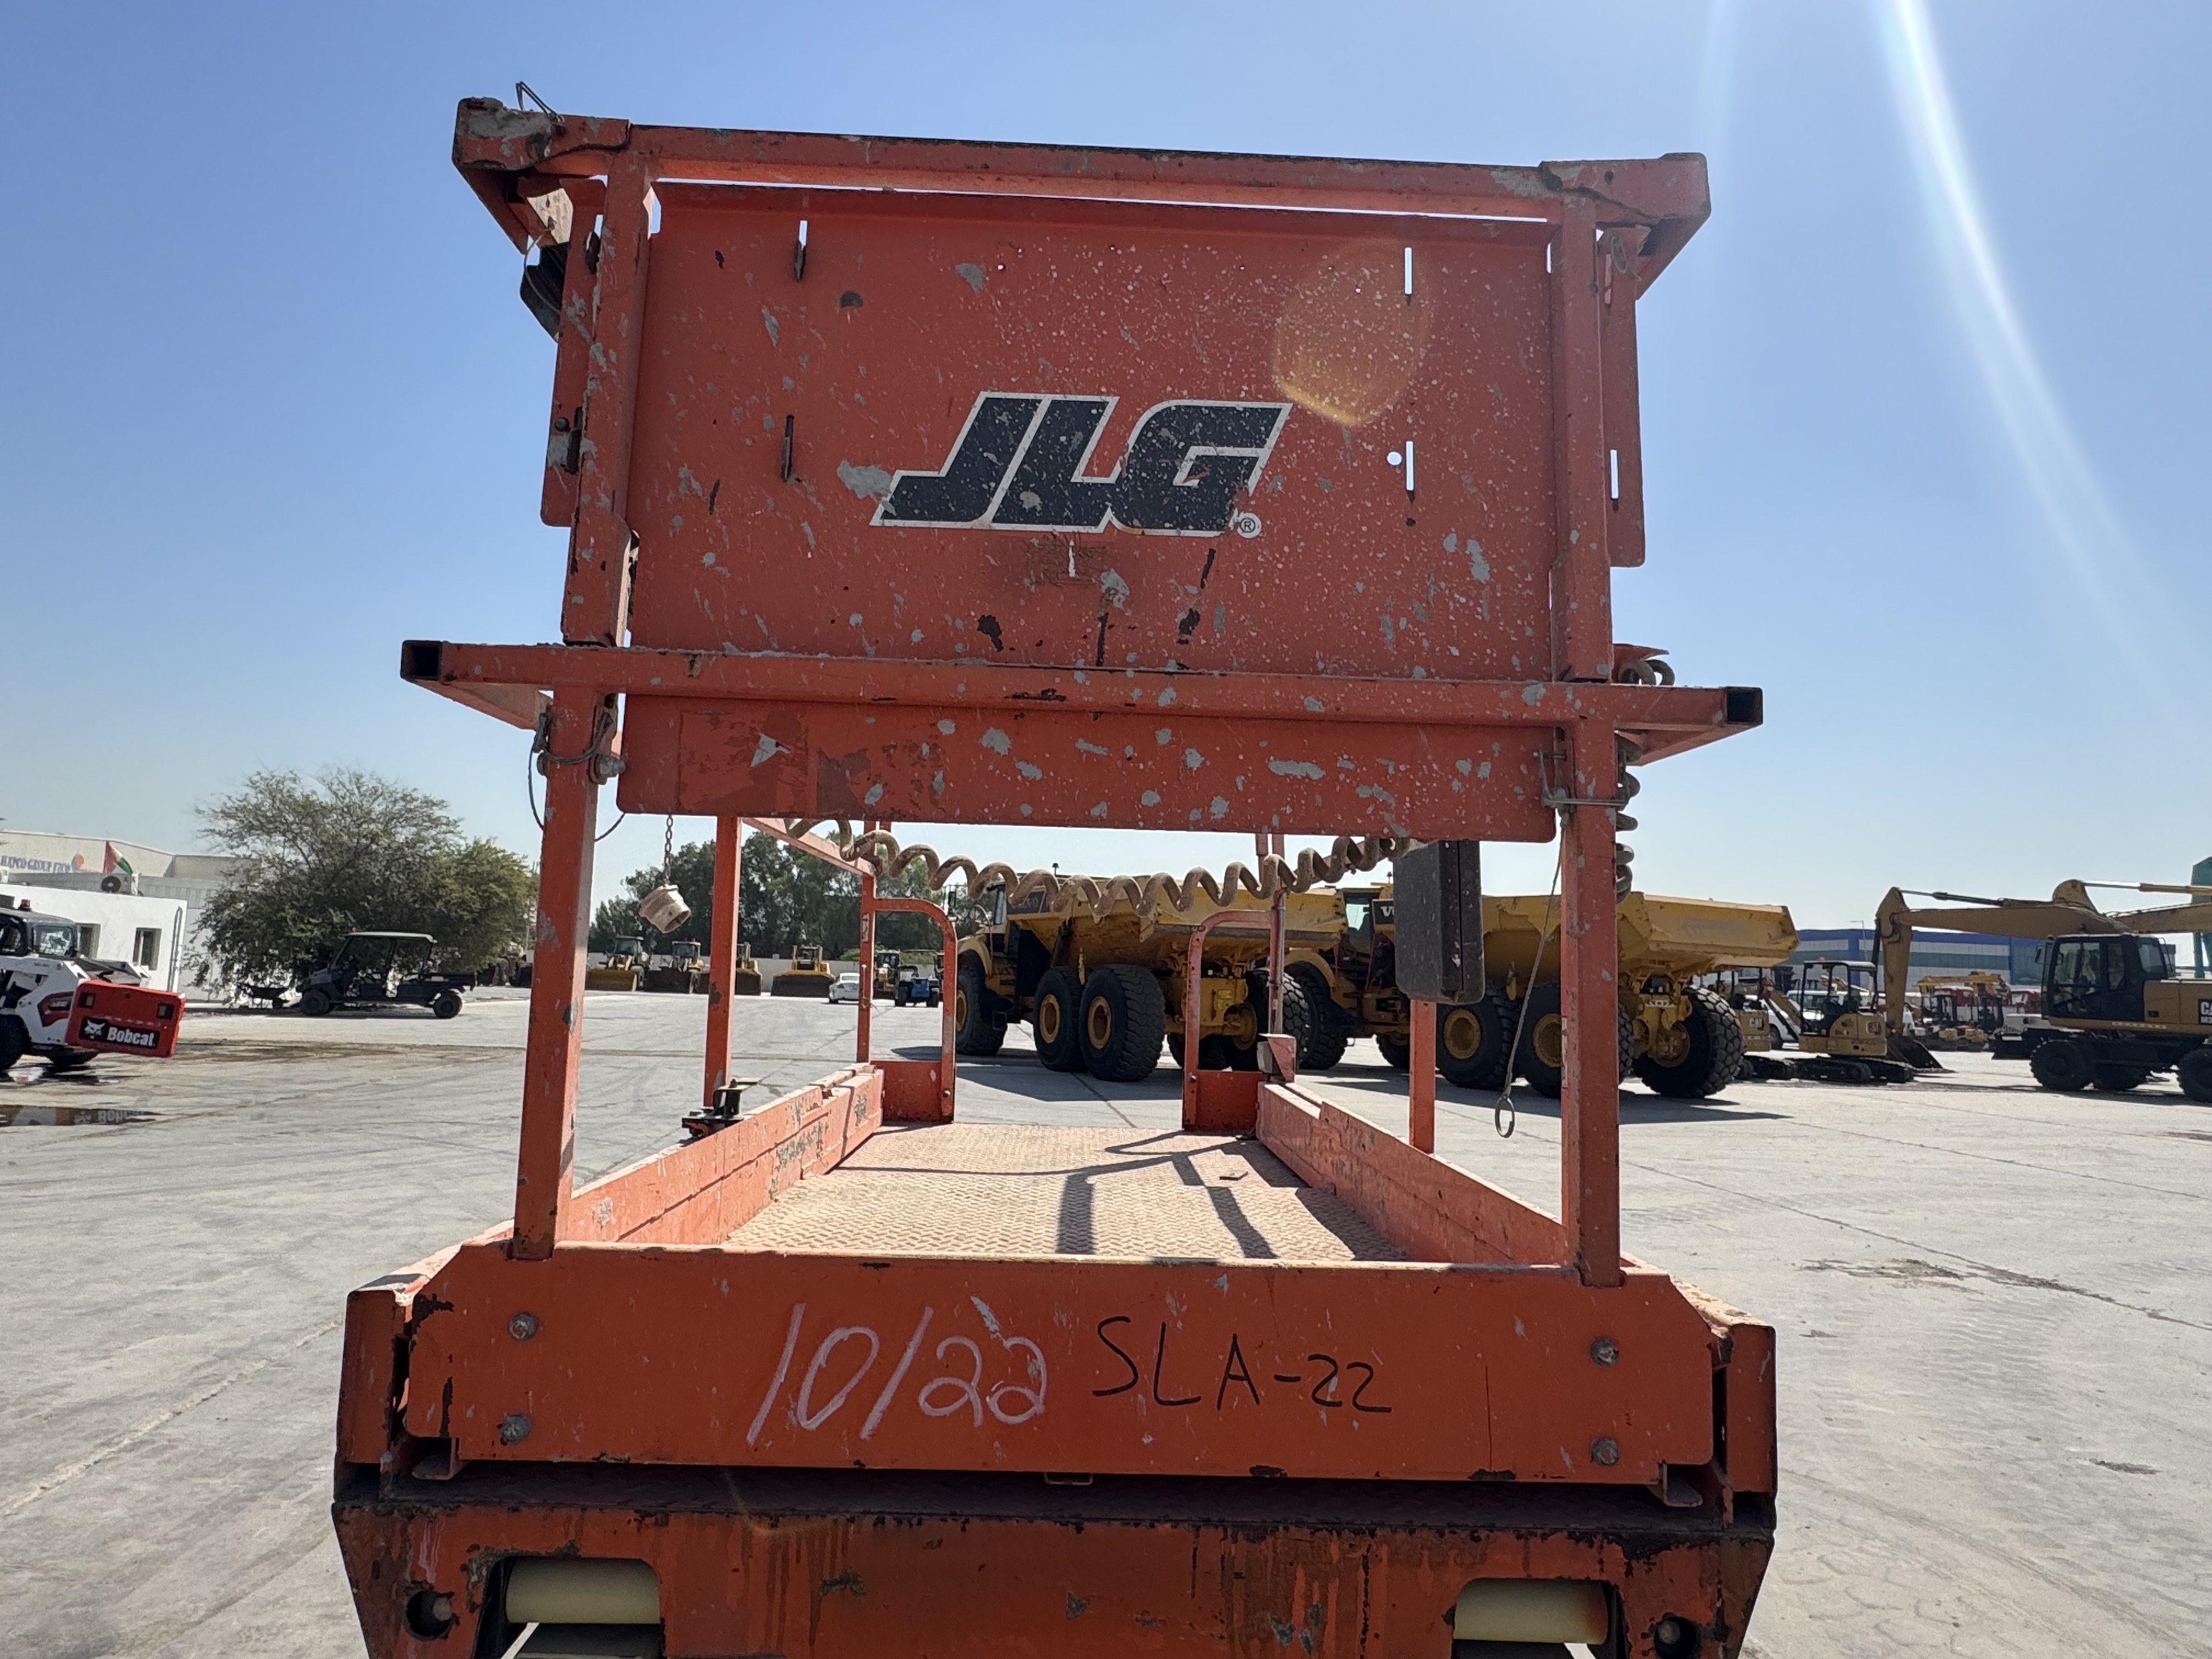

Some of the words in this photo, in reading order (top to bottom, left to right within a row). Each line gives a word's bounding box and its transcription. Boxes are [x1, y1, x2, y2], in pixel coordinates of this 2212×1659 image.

[870, 391, 1293, 538] JLG
[107, 1026, 155, 1047] Bobcat
[1092, 1316, 1392, 1413] SLA-22
